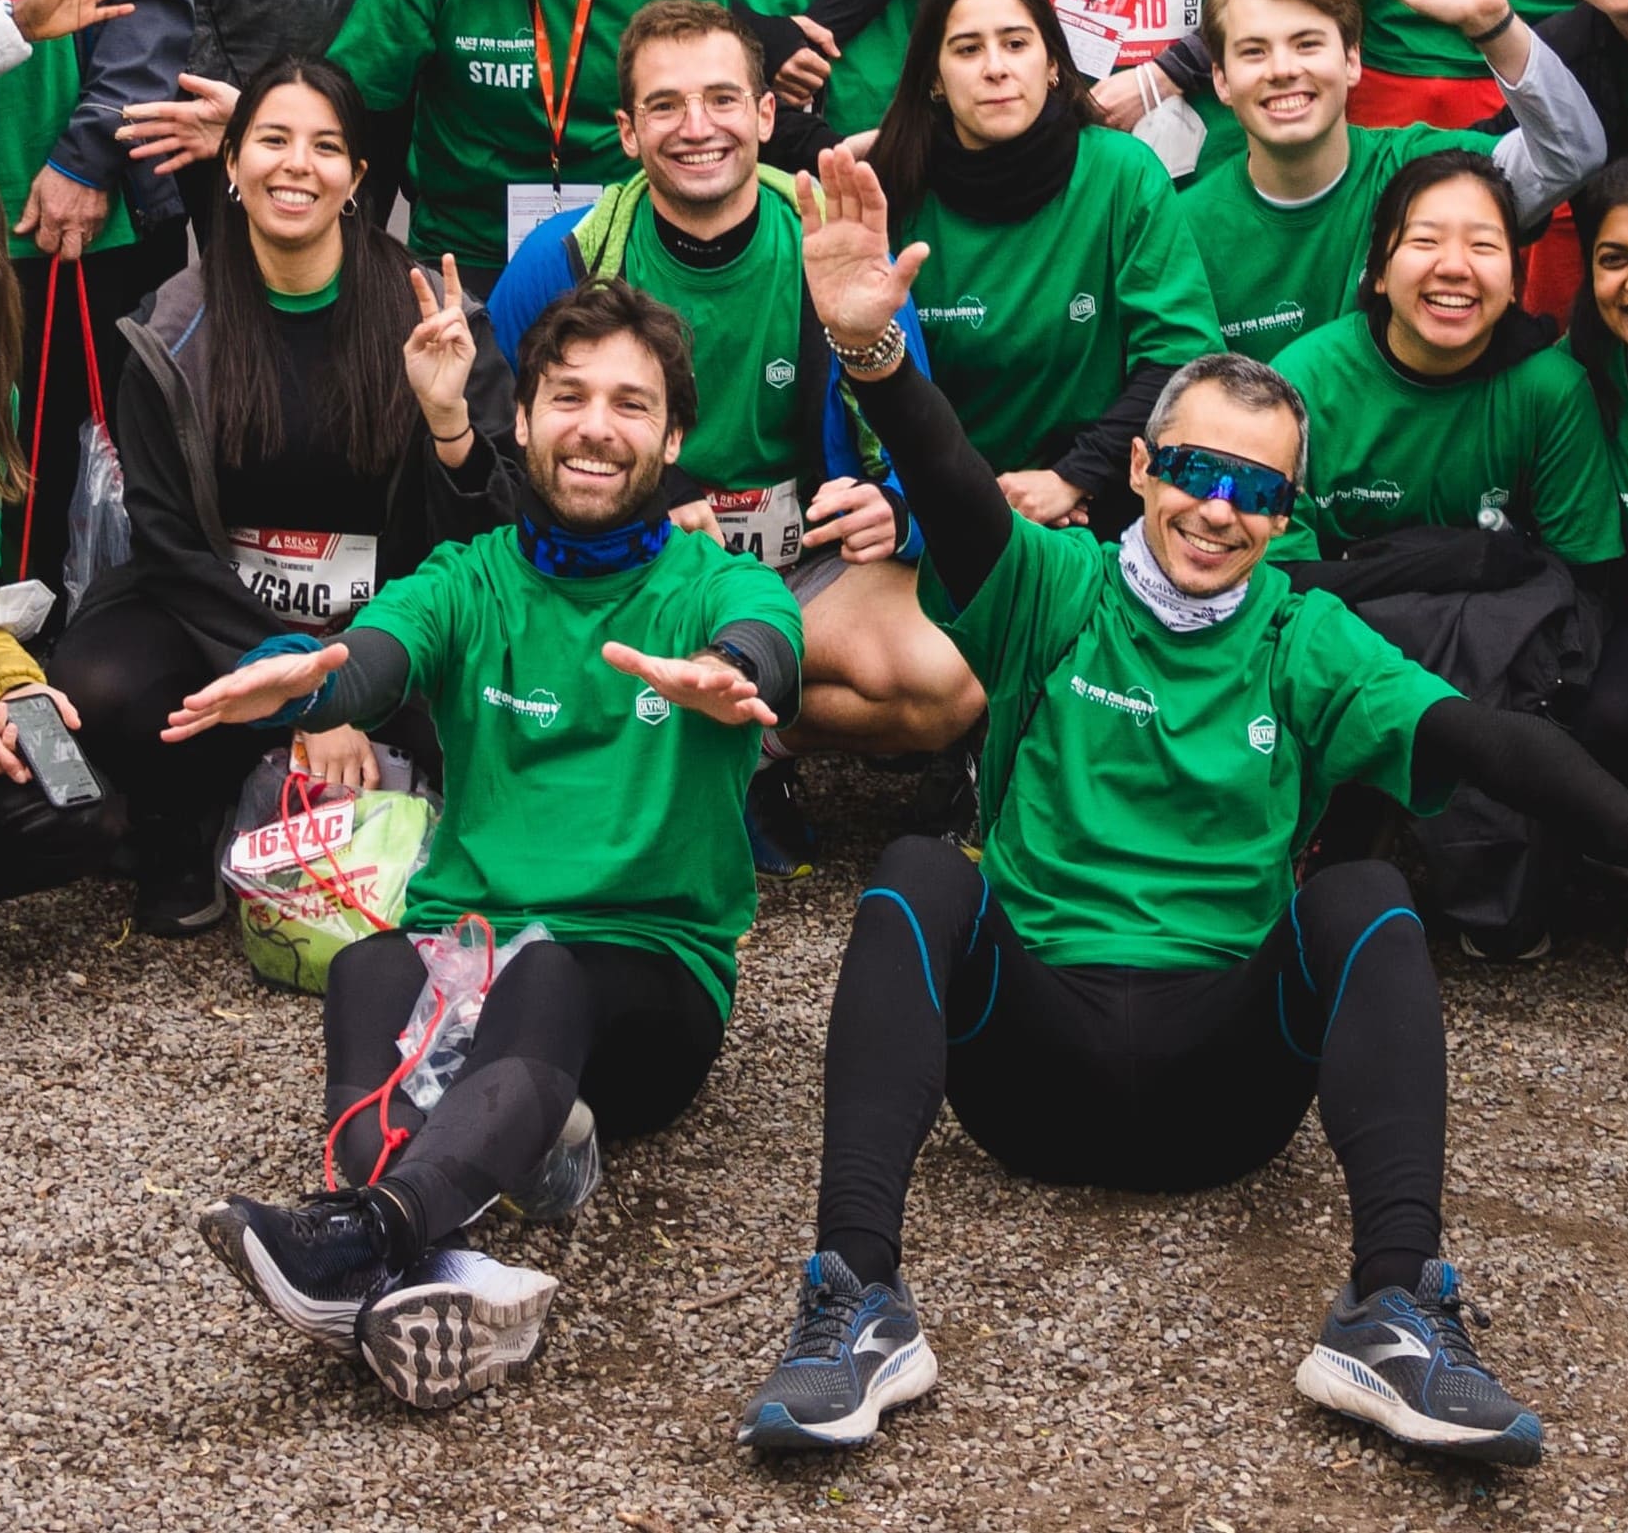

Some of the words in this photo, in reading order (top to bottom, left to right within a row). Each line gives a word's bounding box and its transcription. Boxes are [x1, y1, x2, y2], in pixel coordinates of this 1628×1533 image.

[455, 34, 478, 47] ALICE
[479, 36, 496, 48] FOR
[468, 60, 534, 90] STAFF
[1240, 319, 1258, 332] FOR
[1258, 311, 1298, 327] CHILDREN
[283, 535, 319, 548] RELAY
[250, 570, 332, 618] 1634C
[1088, 684, 1108, 699] FOR
[1107, 691, 1150, 712] CHILDREN
